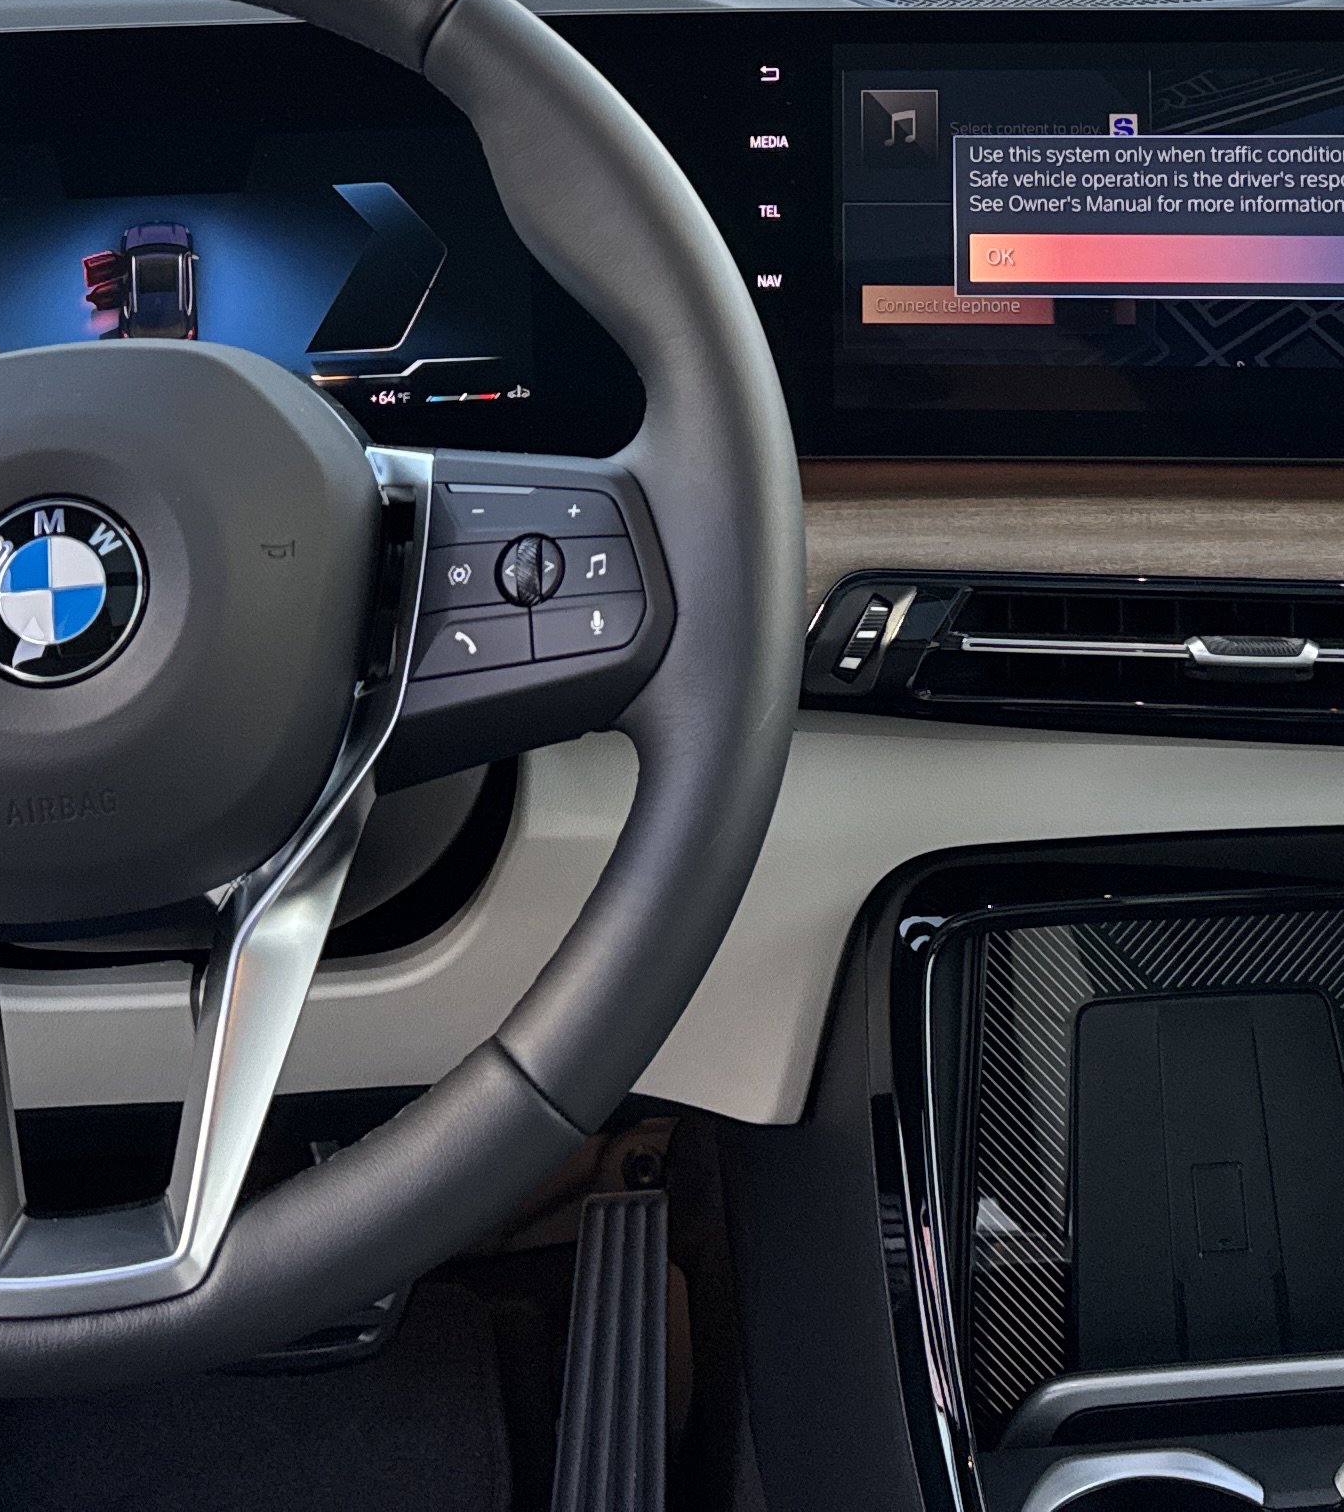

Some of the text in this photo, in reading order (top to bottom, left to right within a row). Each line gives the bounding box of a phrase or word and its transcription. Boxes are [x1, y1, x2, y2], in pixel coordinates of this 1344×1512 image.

[749, 135, 789, 148] MEDIA
[969, 146, 1003, 163] Use
[1009, 145, 1041, 163] this
[1046, 148, 1109, 166] system
[1114, 146, 1153, 166] only
[1156, 146, 1205, 163] when
[1210, 146, 1263, 163] traffic
[969, 170, 1008, 187] Safe
[1013, 170, 1076, 187] vehicle
[1081, 171, 1168, 190] operation
[1174, 170, 1188, 187] is
[1193, 171, 1223, 187] the
[1227, 171, 1295, 188] driver's
[758, 204, 781, 218] TEL
[969, 195, 1003, 212] See
[1008, 195, 1081, 212] Owner's
[1086, 195, 1151, 212] Manual
[1157, 195, 1183, 212] for
[1188, 198, 1234, 212] more
[986, 248, 1015, 265] OK
[757, 274, 782, 287] NAV
[875, 297, 1021, 315] Connect telephone
[370, 390, 396, 405] +64
[7, 789, 118, 826] AIRBAG
